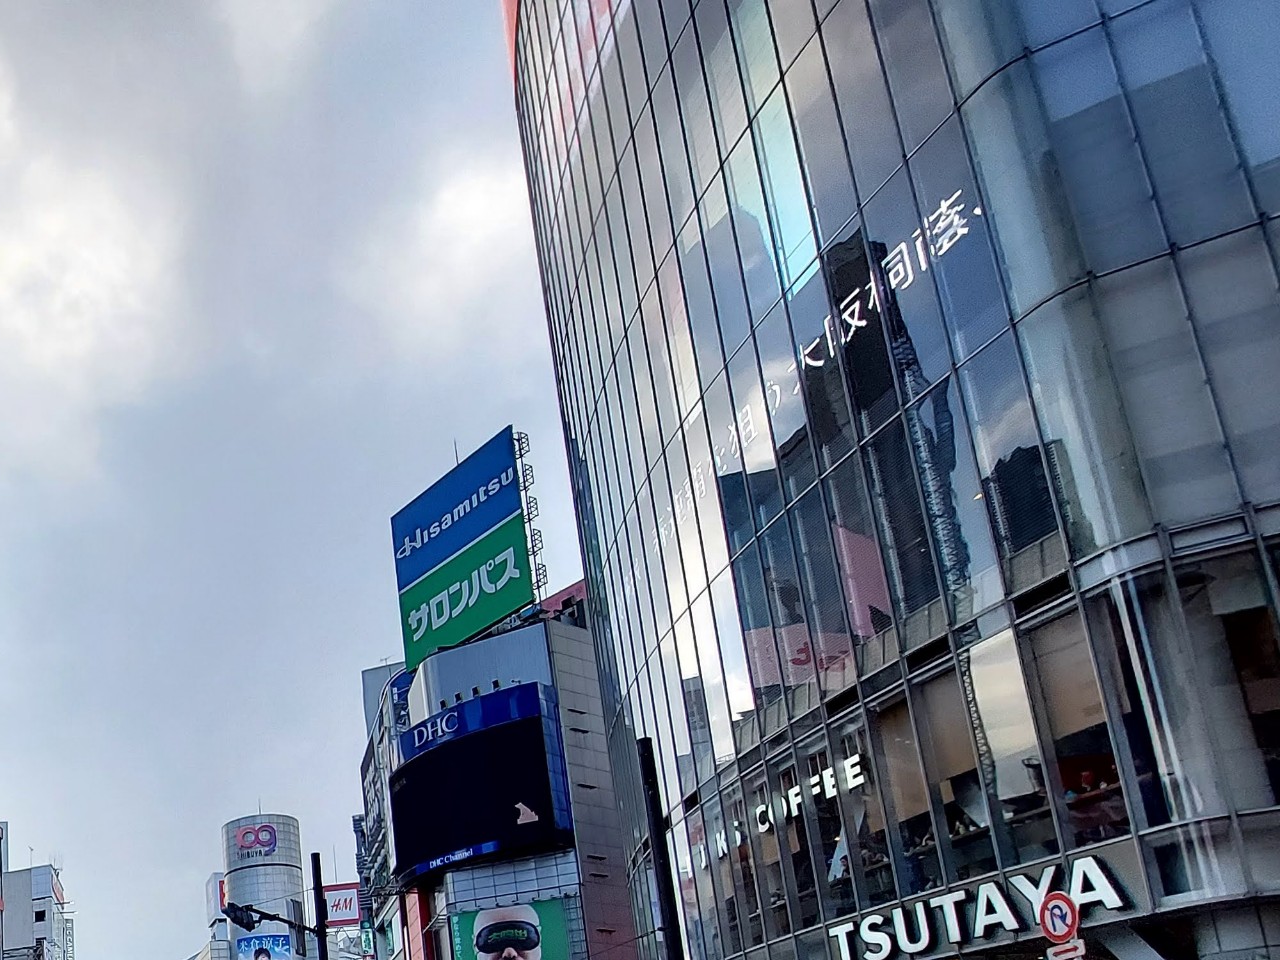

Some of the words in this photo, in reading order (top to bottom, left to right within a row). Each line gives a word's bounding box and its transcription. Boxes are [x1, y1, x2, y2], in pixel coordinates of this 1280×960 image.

[396, 467, 514, 560] Hisamitsu
[408, 546, 520, 642] サロンパス
[413, 712, 459, 748] DHC
[756, 753, 865, 833] COFFEE
[237, 850, 263, 860] SHIBUYA
[430, 857, 443, 869] DHC
[444, 849, 473, 864] Channel
[331, 897, 353, 913] H&M
